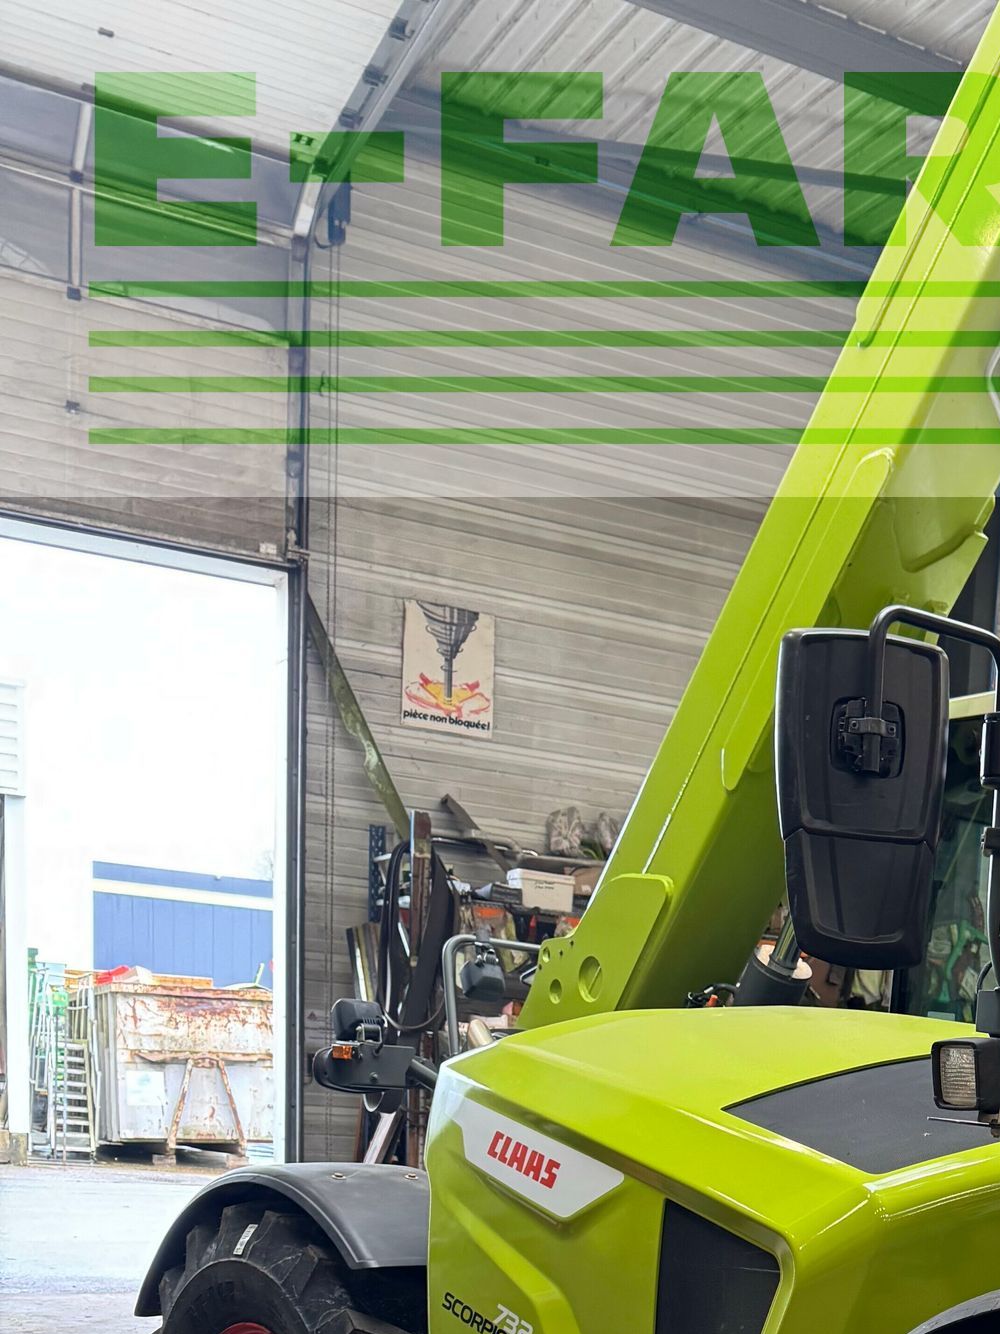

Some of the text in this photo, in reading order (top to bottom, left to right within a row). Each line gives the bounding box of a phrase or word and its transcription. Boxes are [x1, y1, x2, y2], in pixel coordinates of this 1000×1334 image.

[403, 708, 429, 720] pièce
[430, 715, 447, 723] non
[487, 1131, 561, 1190] CLAAS
